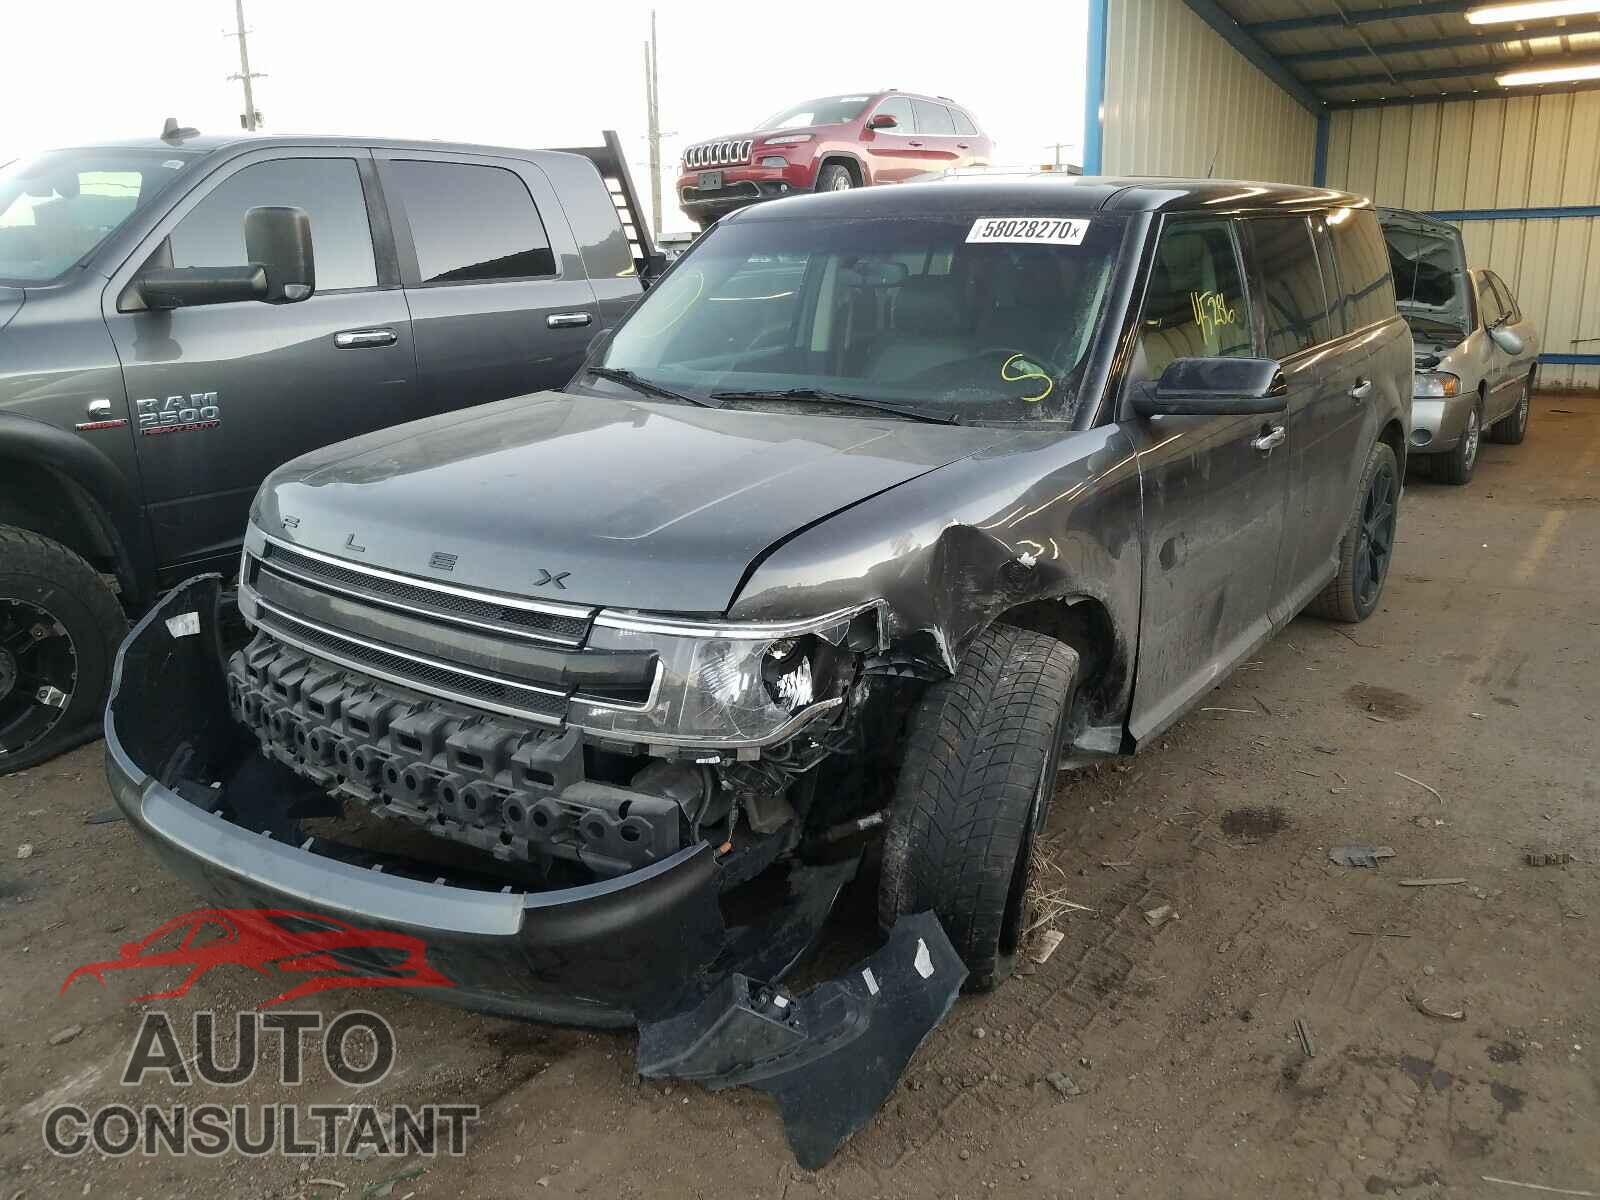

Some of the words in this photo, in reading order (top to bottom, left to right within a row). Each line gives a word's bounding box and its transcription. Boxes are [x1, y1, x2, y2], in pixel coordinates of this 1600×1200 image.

[136, 392, 218, 411] RAM
[139, 406, 220, 426] 2500
[281, 514, 571, 590] FLEX
